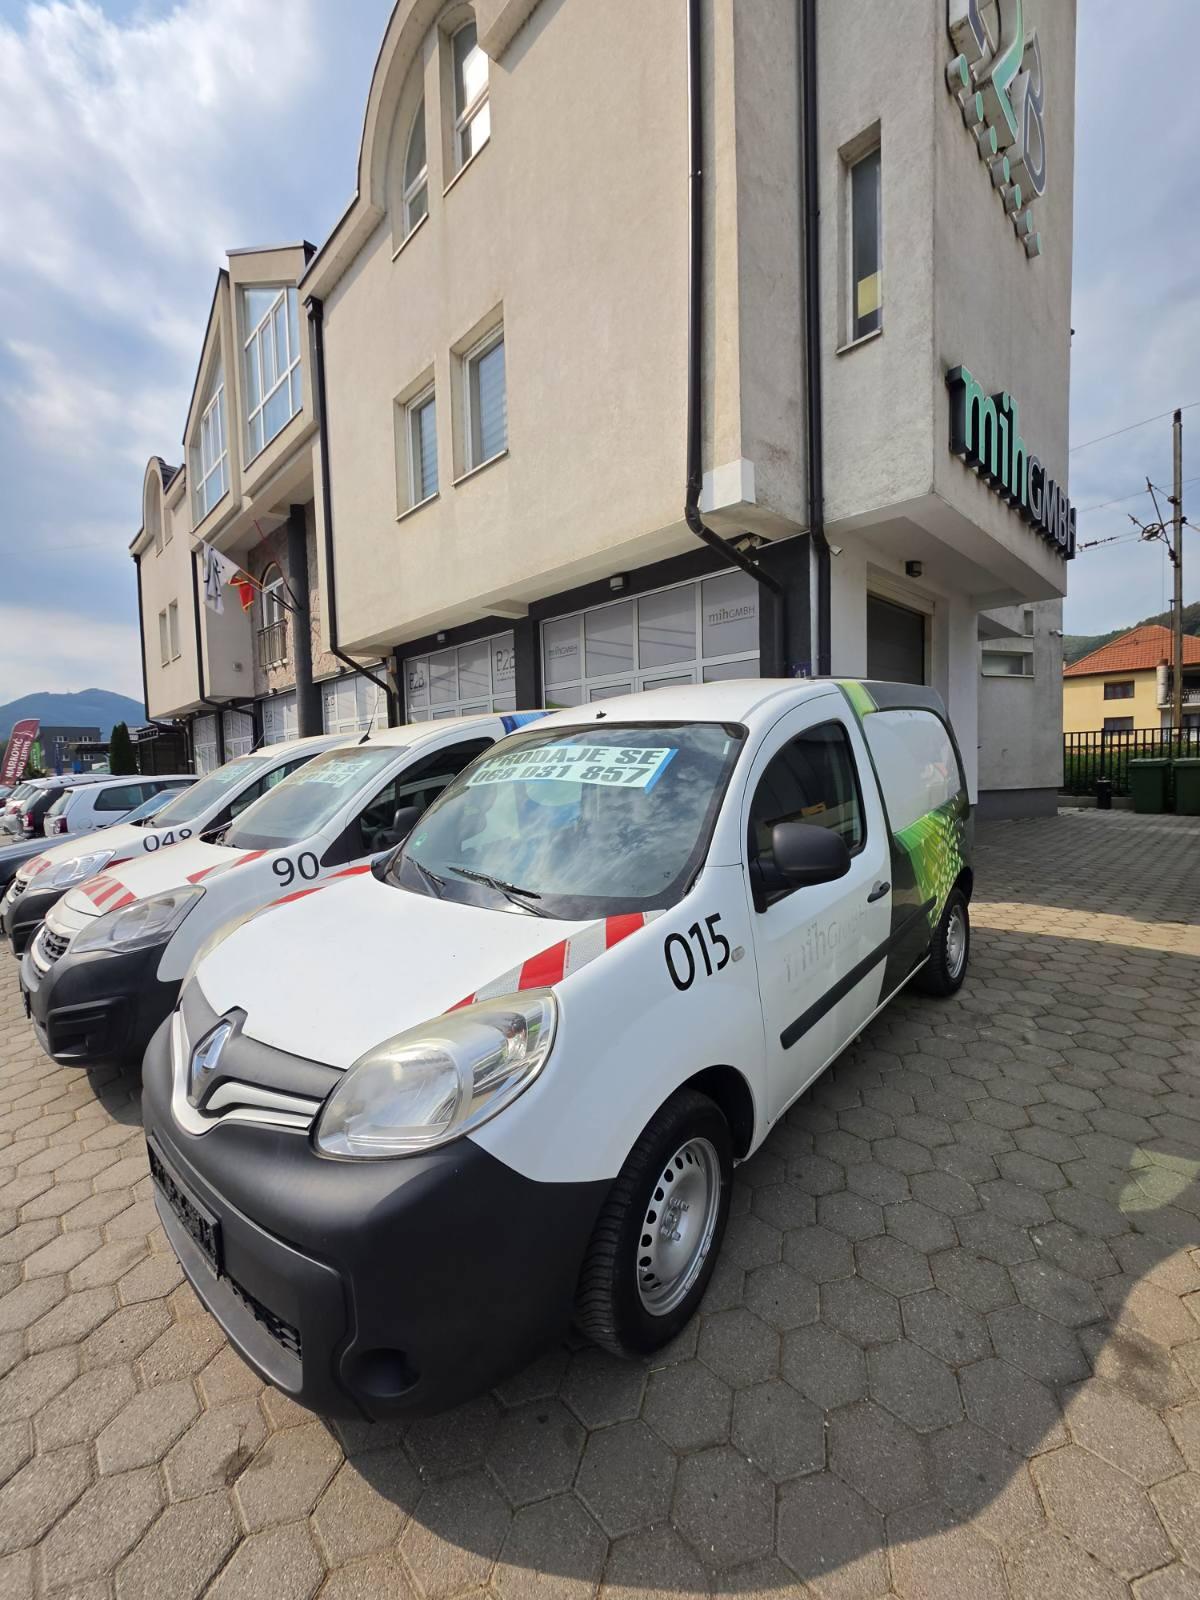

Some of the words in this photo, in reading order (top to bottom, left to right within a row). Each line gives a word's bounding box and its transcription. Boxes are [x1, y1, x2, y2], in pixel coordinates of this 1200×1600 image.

[949, 365, 1076, 558] mihGMBH
[483, 749, 609, 769] PRODAJE
[614, 750, 664, 765] SE
[519, 765, 571, 778] 031
[579, 766, 651, 784] 857
[272, 852, 319, 886] 90
[664, 913, 731, 991] 015
